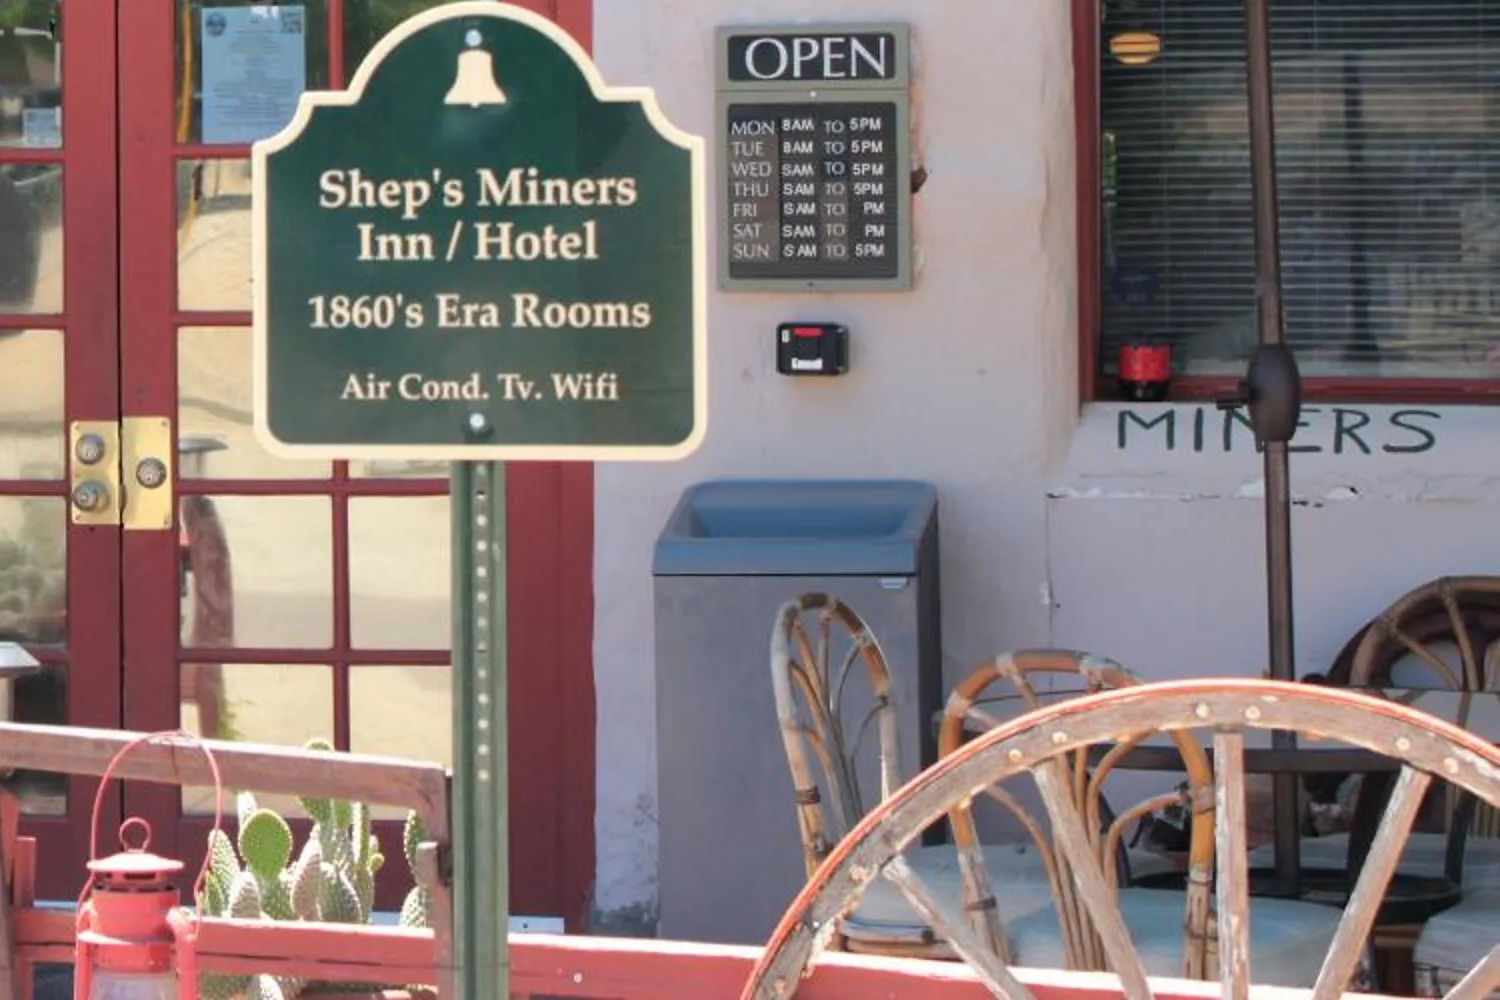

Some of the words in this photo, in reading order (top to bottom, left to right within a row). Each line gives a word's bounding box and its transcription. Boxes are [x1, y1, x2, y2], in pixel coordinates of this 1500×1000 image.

[745, 36, 886, 79] OPEN
[731, 120, 775, 136] MON
[824, 120, 845, 134] TO
[732, 141, 765, 157] TUE
[824, 141, 845, 155] TO
[732, 161, 772, 177] WED
[824, 161, 845, 176] TO
[319, 168, 465, 220] Shep's
[476, 167, 637, 207] Miners
[733, 183, 769, 197] THU
[825, 182, 845, 196] TO
[732, 203, 758, 217] FRI
[824, 203, 845, 217] TO
[732, 223, 763, 238] SAT
[825, 223, 846, 237] TO
[357, 222, 435, 262] Inn
[473, 221, 599, 260] Hotel
[733, 243, 770, 259] SUN
[826, 244, 846, 258] TO
[308, 293, 424, 329] 1860's
[435, 293, 501, 329] Era
[511, 293, 652, 329] Rooms
[339, 373, 391, 401] Air
[398, 373, 490, 401] Cond.
[497, 373, 543, 401] Tv.
[552, 373, 619, 401] Wifi
